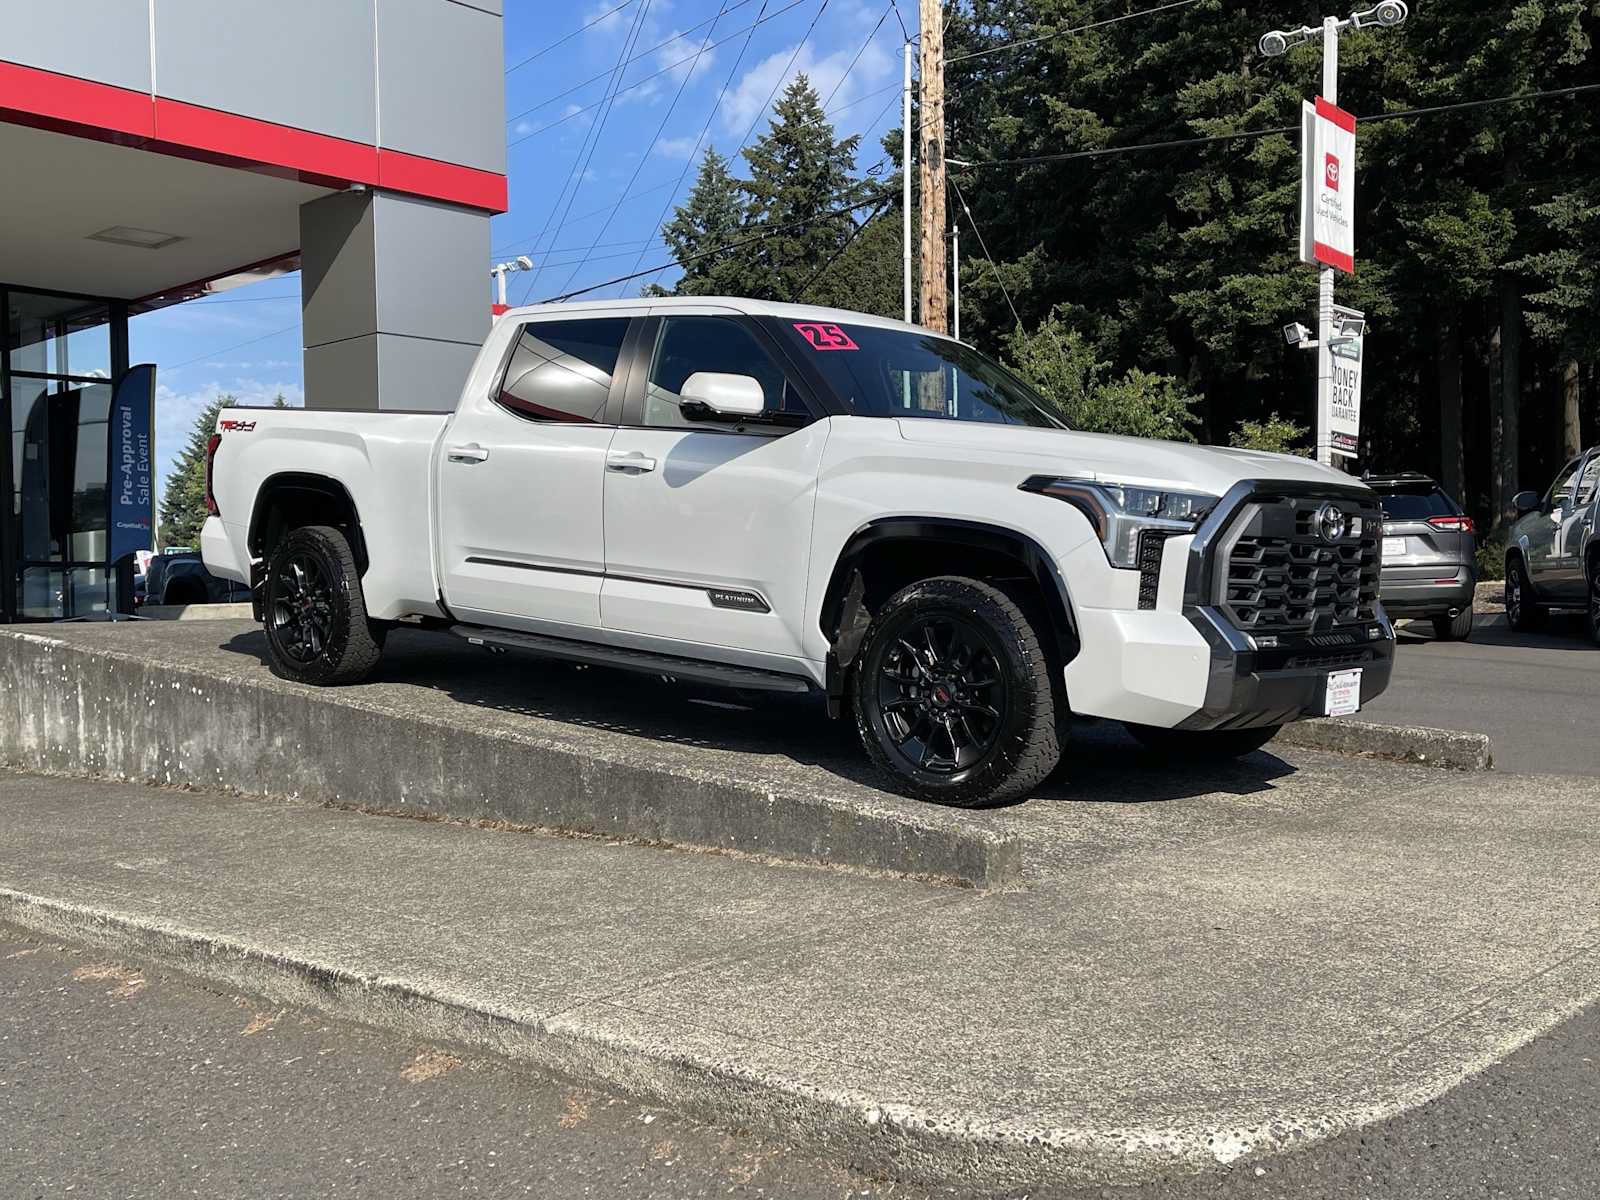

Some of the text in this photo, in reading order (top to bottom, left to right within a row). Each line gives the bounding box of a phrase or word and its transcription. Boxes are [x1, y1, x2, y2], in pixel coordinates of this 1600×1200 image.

[800, 325, 849, 346] 25
[1332, 386, 1354, 408] BACK
[120, 406, 134, 505] Pre-Approval
[137, 433, 149, 505] Sale Event
[715, 593, 755, 603] PLATINUM
